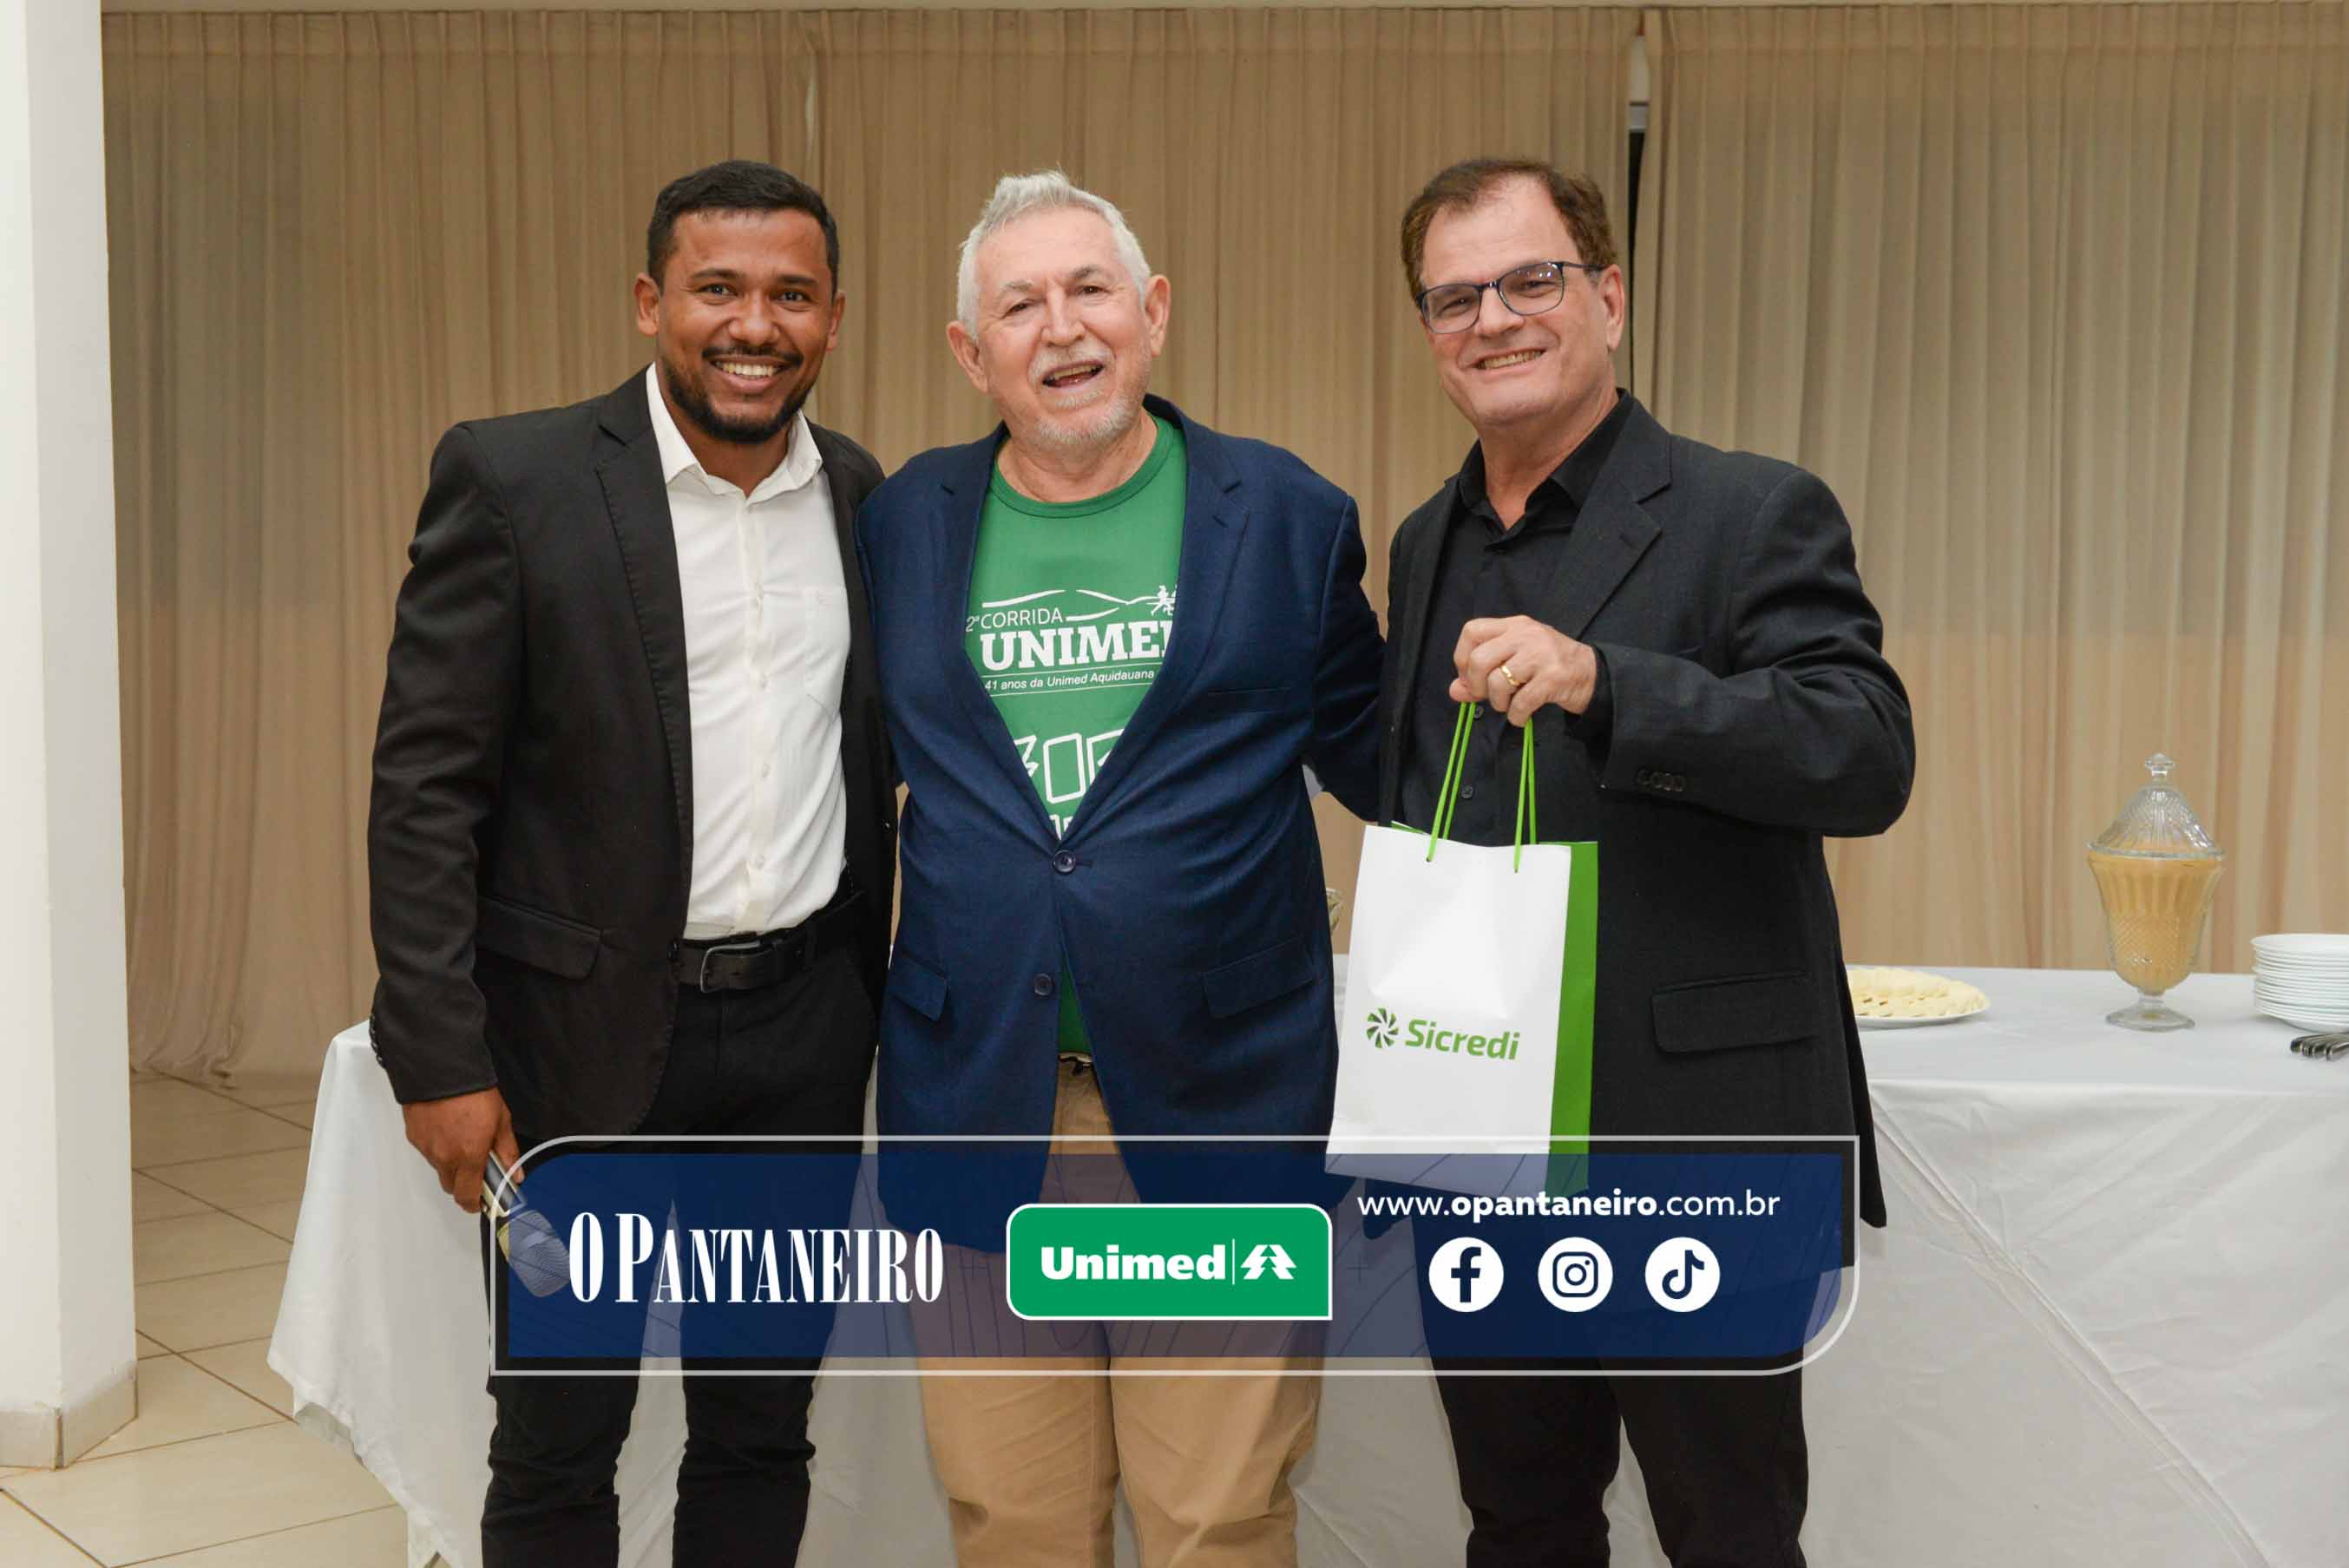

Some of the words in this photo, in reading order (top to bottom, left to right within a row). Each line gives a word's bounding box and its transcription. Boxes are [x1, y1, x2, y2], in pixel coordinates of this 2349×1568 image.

[981, 607, 1063, 629] CORRIDA
[985, 679, 998, 691] 41
[1001, 679, 1027, 690] anos
[1030, 677, 1043, 688] da
[1047, 672, 1088, 686] Unimed
[1090, 670, 1155, 684] Aquidauana
[1404, 1018, 1520, 1060] Sicredi
